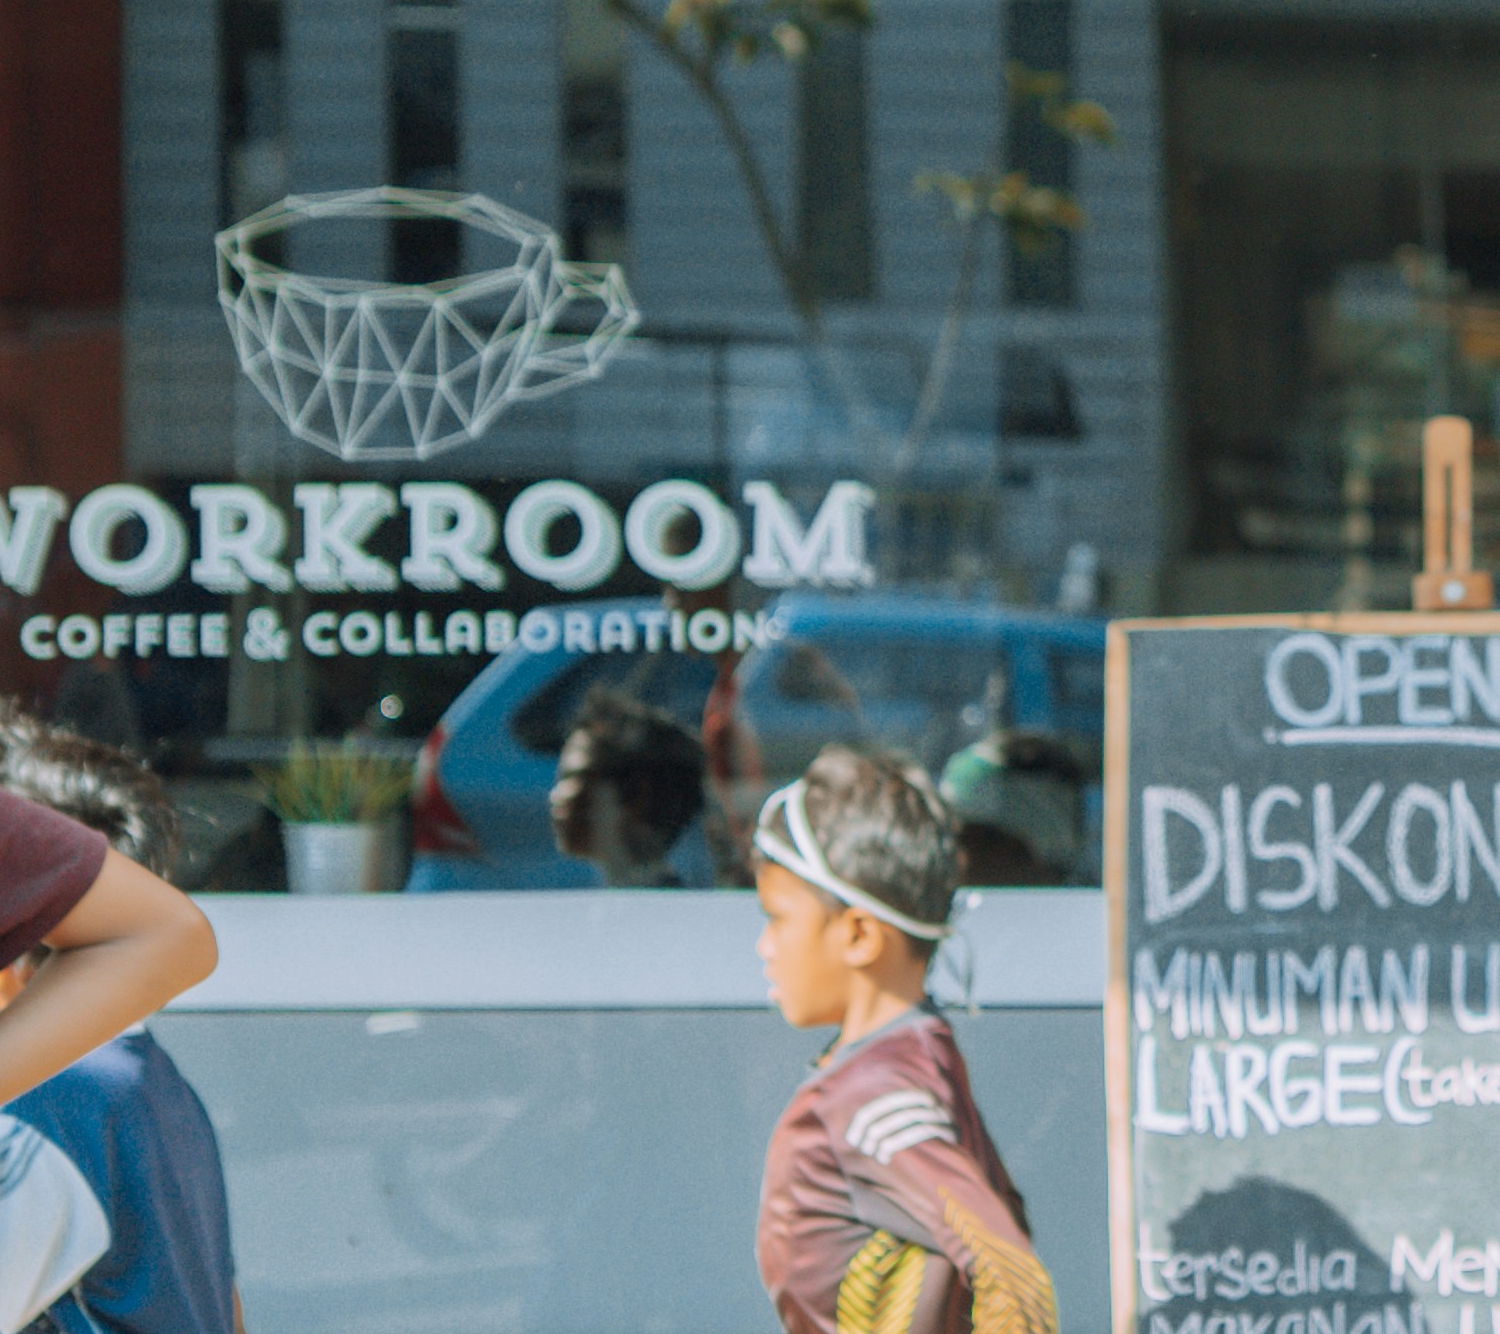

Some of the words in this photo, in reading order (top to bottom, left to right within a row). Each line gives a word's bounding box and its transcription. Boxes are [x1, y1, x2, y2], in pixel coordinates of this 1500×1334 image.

[21, 613, 227, 659] COFFEE
[244, 608, 288, 661] &
[302, 608, 769, 656] COLLABORATION
[1133, 943, 1429, 1041] MINUMAN
